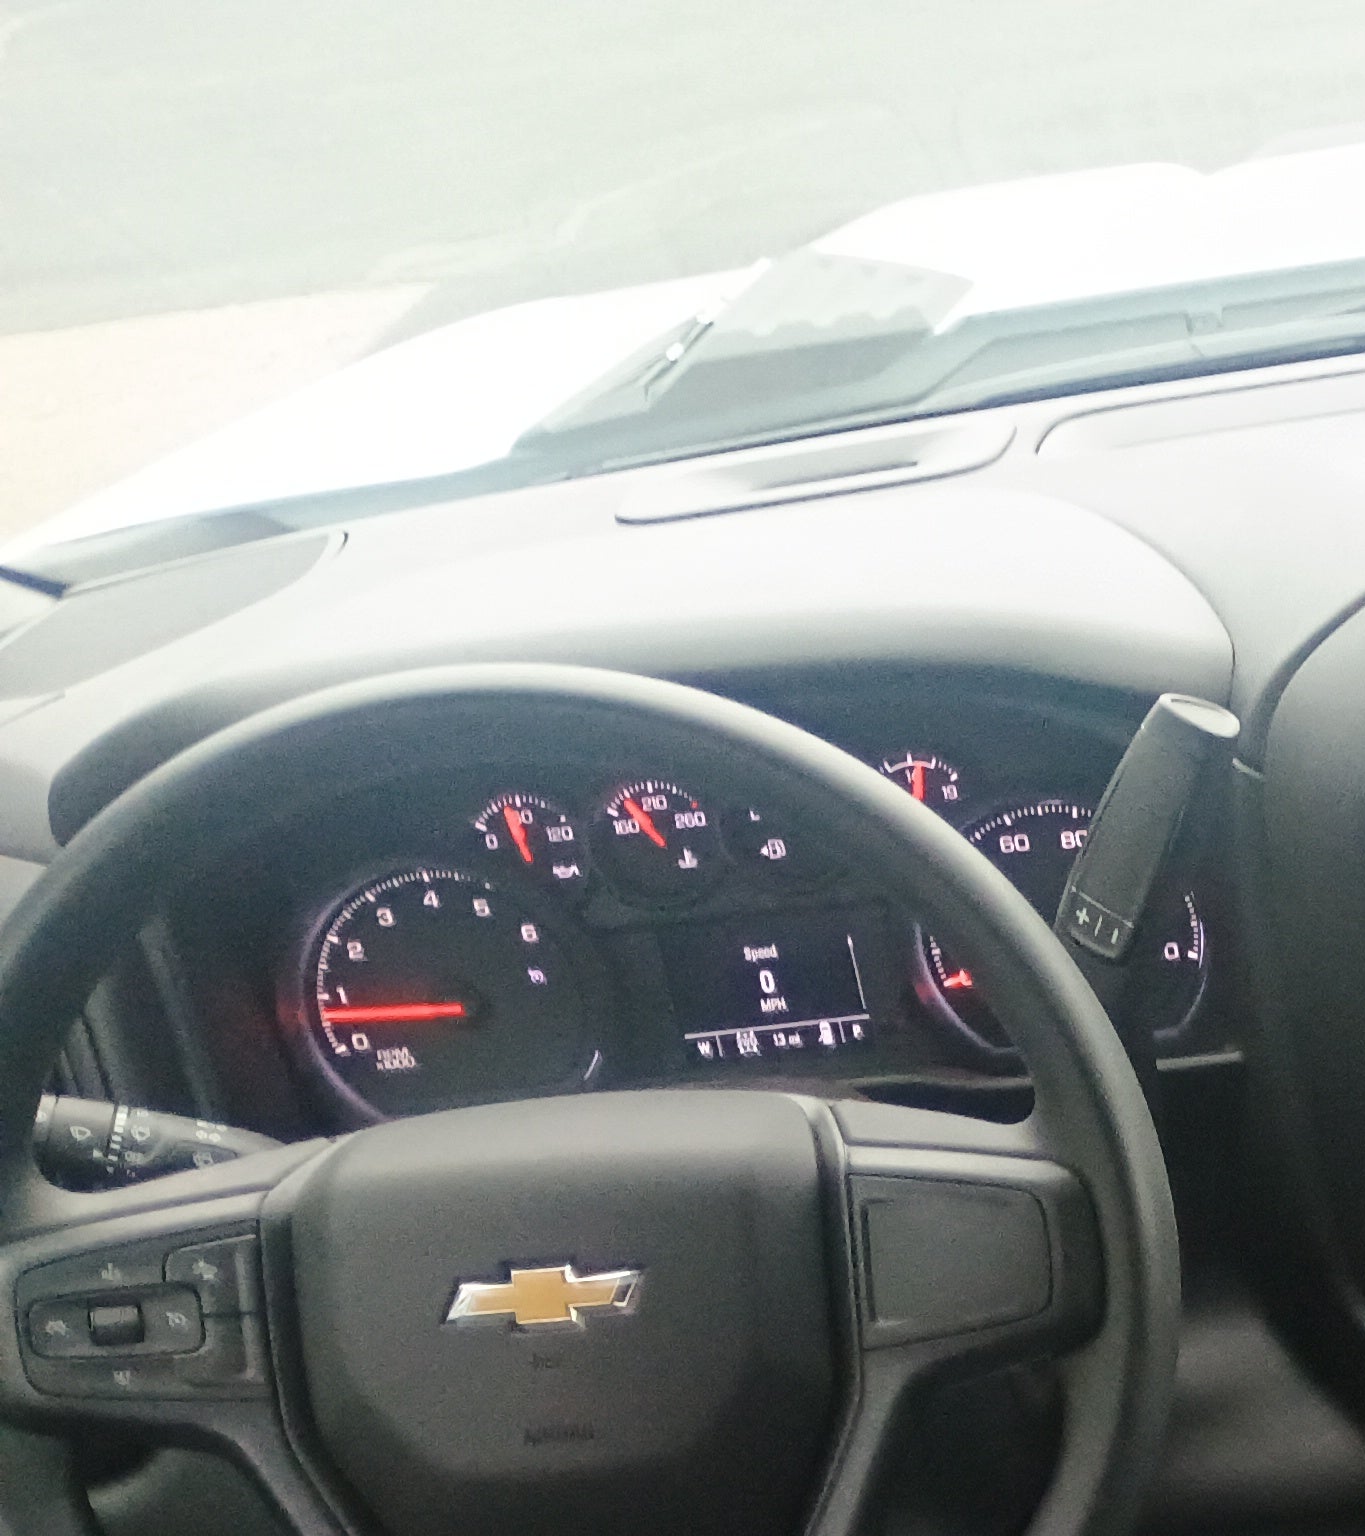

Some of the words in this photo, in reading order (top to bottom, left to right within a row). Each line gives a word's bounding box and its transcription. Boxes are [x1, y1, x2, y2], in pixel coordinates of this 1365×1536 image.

[613, 819, 641, 835] 100
[485, 834, 499, 850] 0
[1000, 833, 1030, 853] 60
[423, 890, 440, 908] 4
[473, 898, 492, 917] 5
[376, 907, 396, 927] 3
[521, 923, 539, 942] 6
[347, 940, 366, 961] 2
[743, 943, 779, 962] Speed
[760, 970, 775, 993] 0
[336, 985, 348, 1004] 1
[760, 997, 788, 1014] MPH
[352, 1033, 370, 1050] 0
